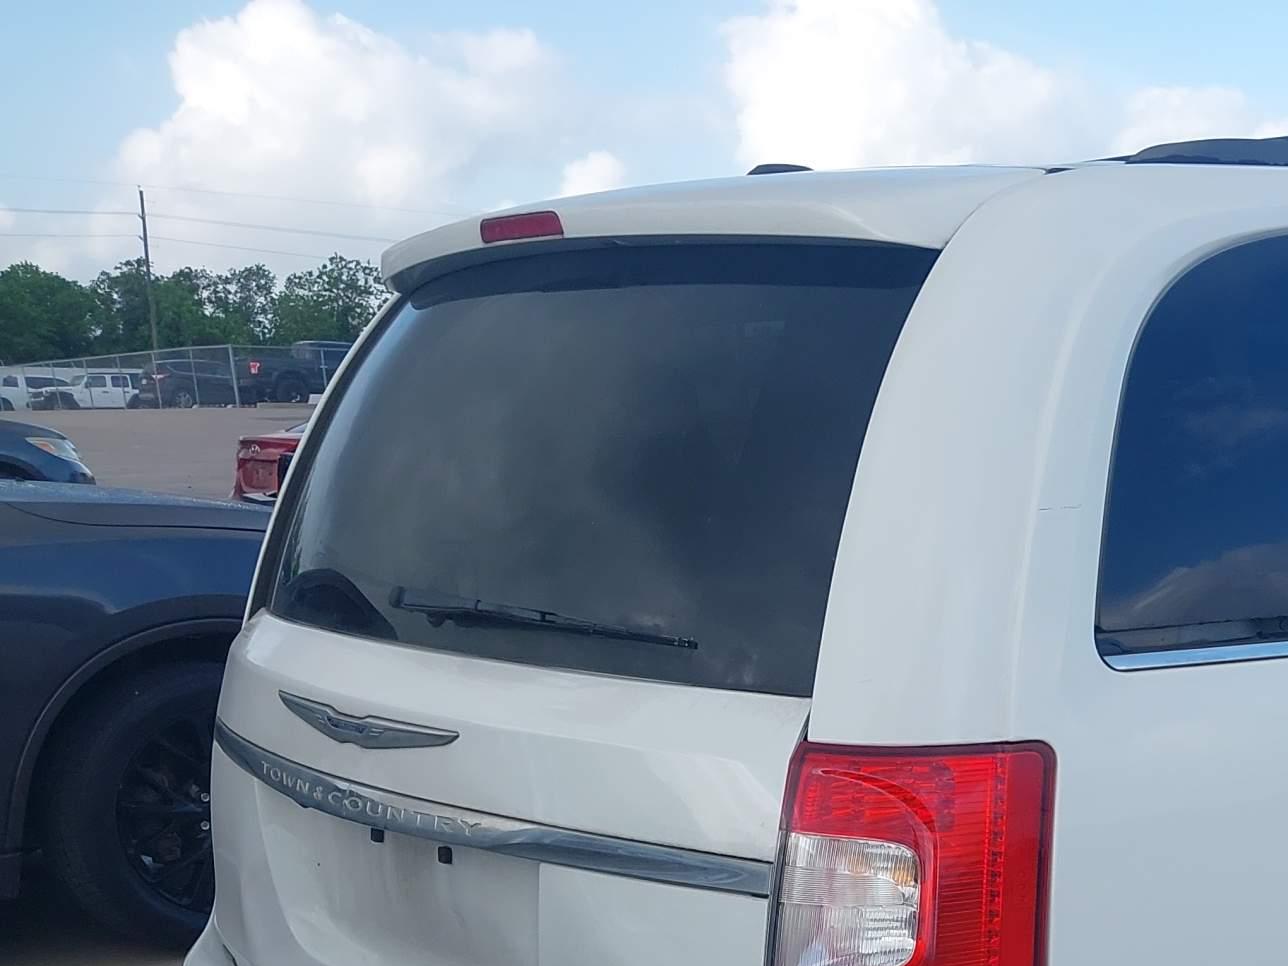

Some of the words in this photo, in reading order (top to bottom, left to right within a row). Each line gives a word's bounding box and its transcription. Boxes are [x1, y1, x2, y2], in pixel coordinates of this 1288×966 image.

[260, 760, 309, 794] TOWN
[313, 786, 323, 800] &
[328, 791, 482, 837] COUNTRY
